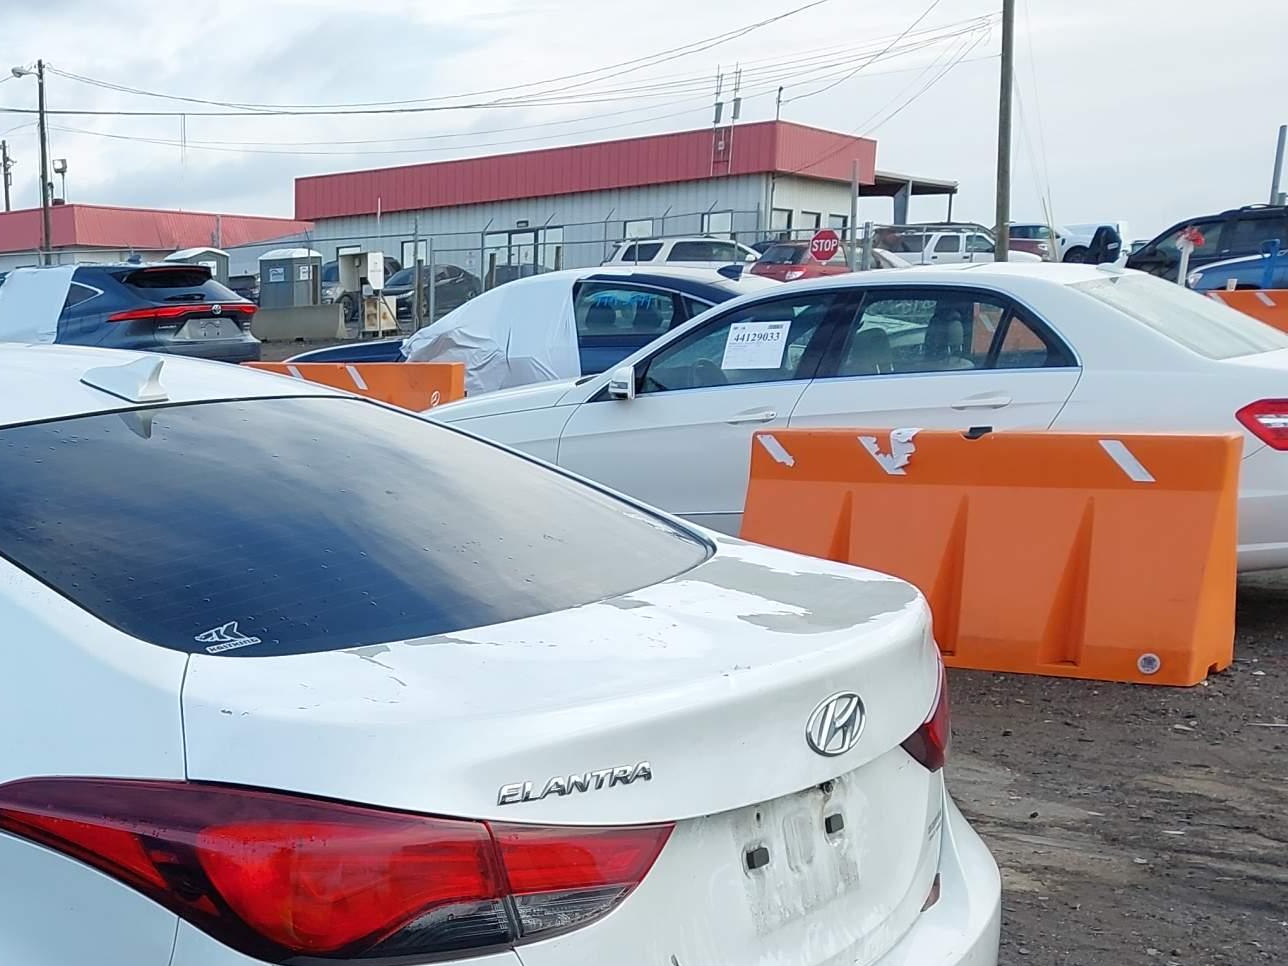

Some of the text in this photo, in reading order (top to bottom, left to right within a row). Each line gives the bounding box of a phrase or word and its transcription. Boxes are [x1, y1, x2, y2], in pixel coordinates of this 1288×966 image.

[812, 239, 838, 252] STOP
[733, 331, 781, 342] 44129033
[497, 760, 652, 806] ELANTRA
